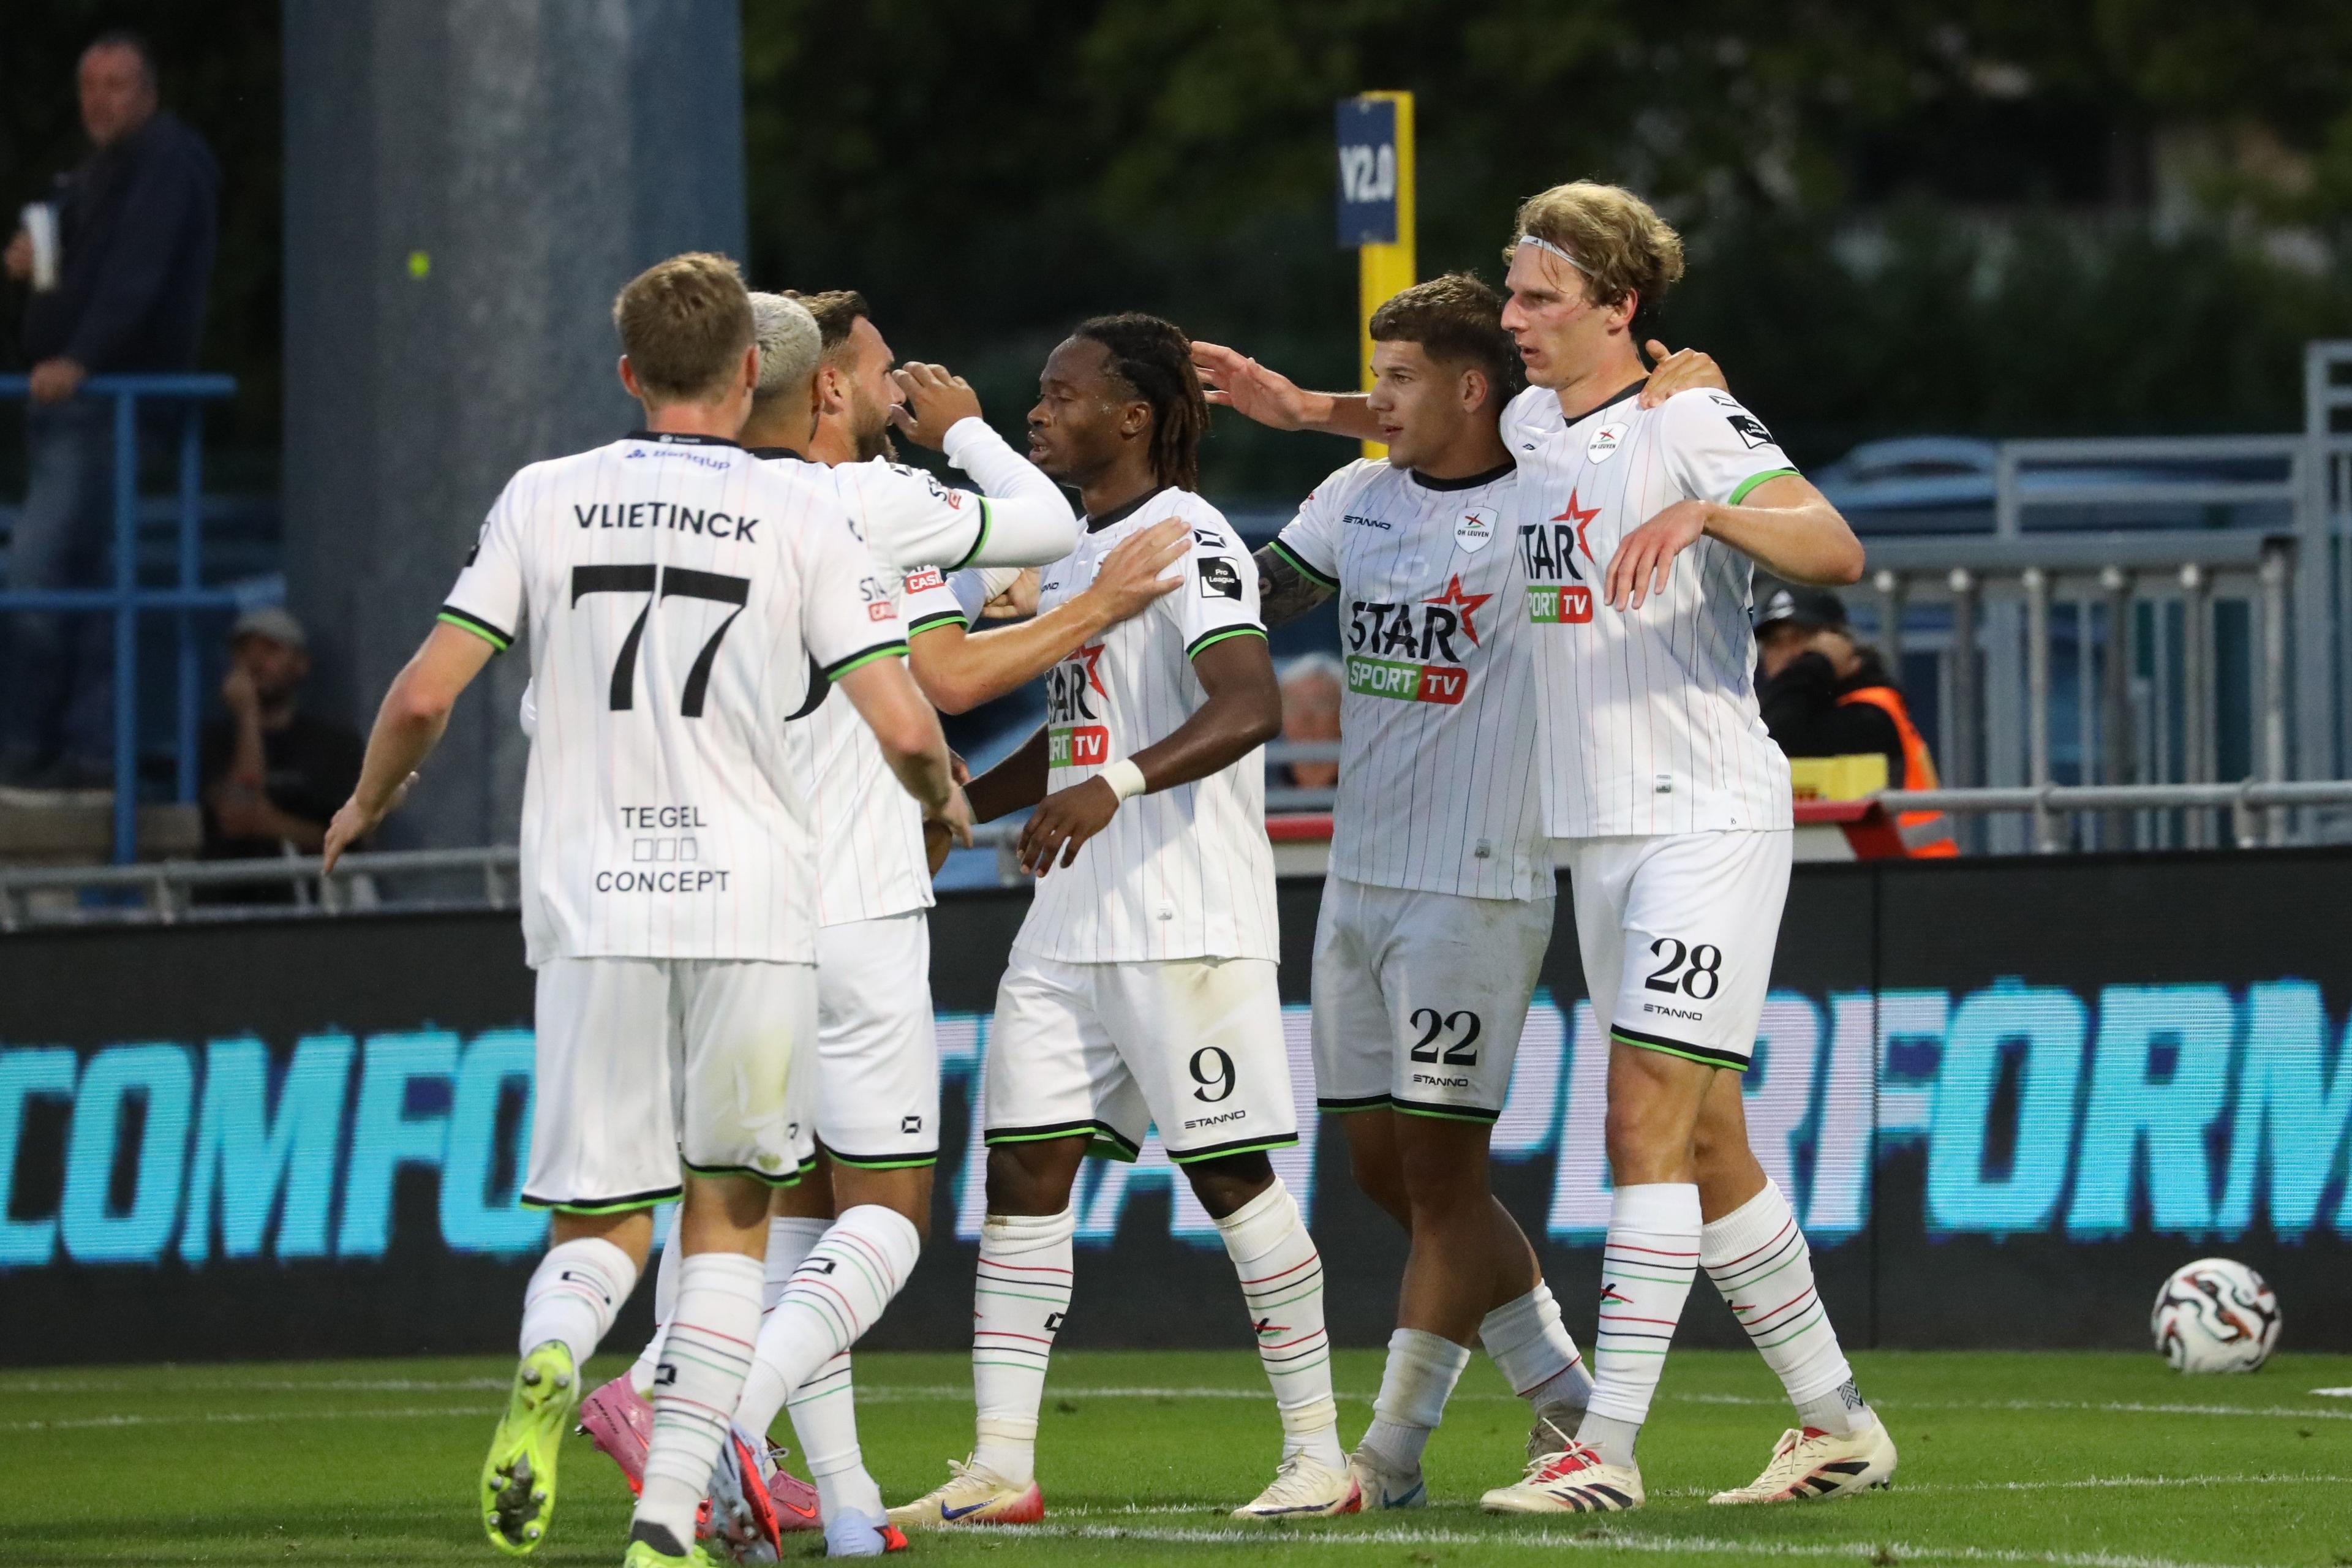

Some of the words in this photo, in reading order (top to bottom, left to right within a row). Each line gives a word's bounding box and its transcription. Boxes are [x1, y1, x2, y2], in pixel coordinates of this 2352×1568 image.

[575, 502, 760, 543] VLIETINCK
[1343, 515, 1391, 530] STANNO
[1518, 523, 1583, 580] TAR
[1528, 592, 1558, 617] ORT
[1563, 593, 1588, 614] TV
[570, 564, 751, 718] 77
[1348, 601, 1461, 663] STAR
[1350, 660, 1416, 693] SPORT
[1427, 675, 1460, 695] TV
[1075, 734, 1102, 756] TV
[621, 806, 707, 829] TEGEL
[596, 870, 730, 892] CONCEPT
[1645, 938, 1722, 1000] 28
[1643, 1003, 1703, 1022] STANNO
[1409, 1008, 1482, 1066] 22
[1189, 1046, 1236, 1102] 9
[1413, 1074, 1468, 1088] STANNO
[1185, 1109, 1246, 1129] STANNO
[0, 1027, 554, 1267] COMFO
